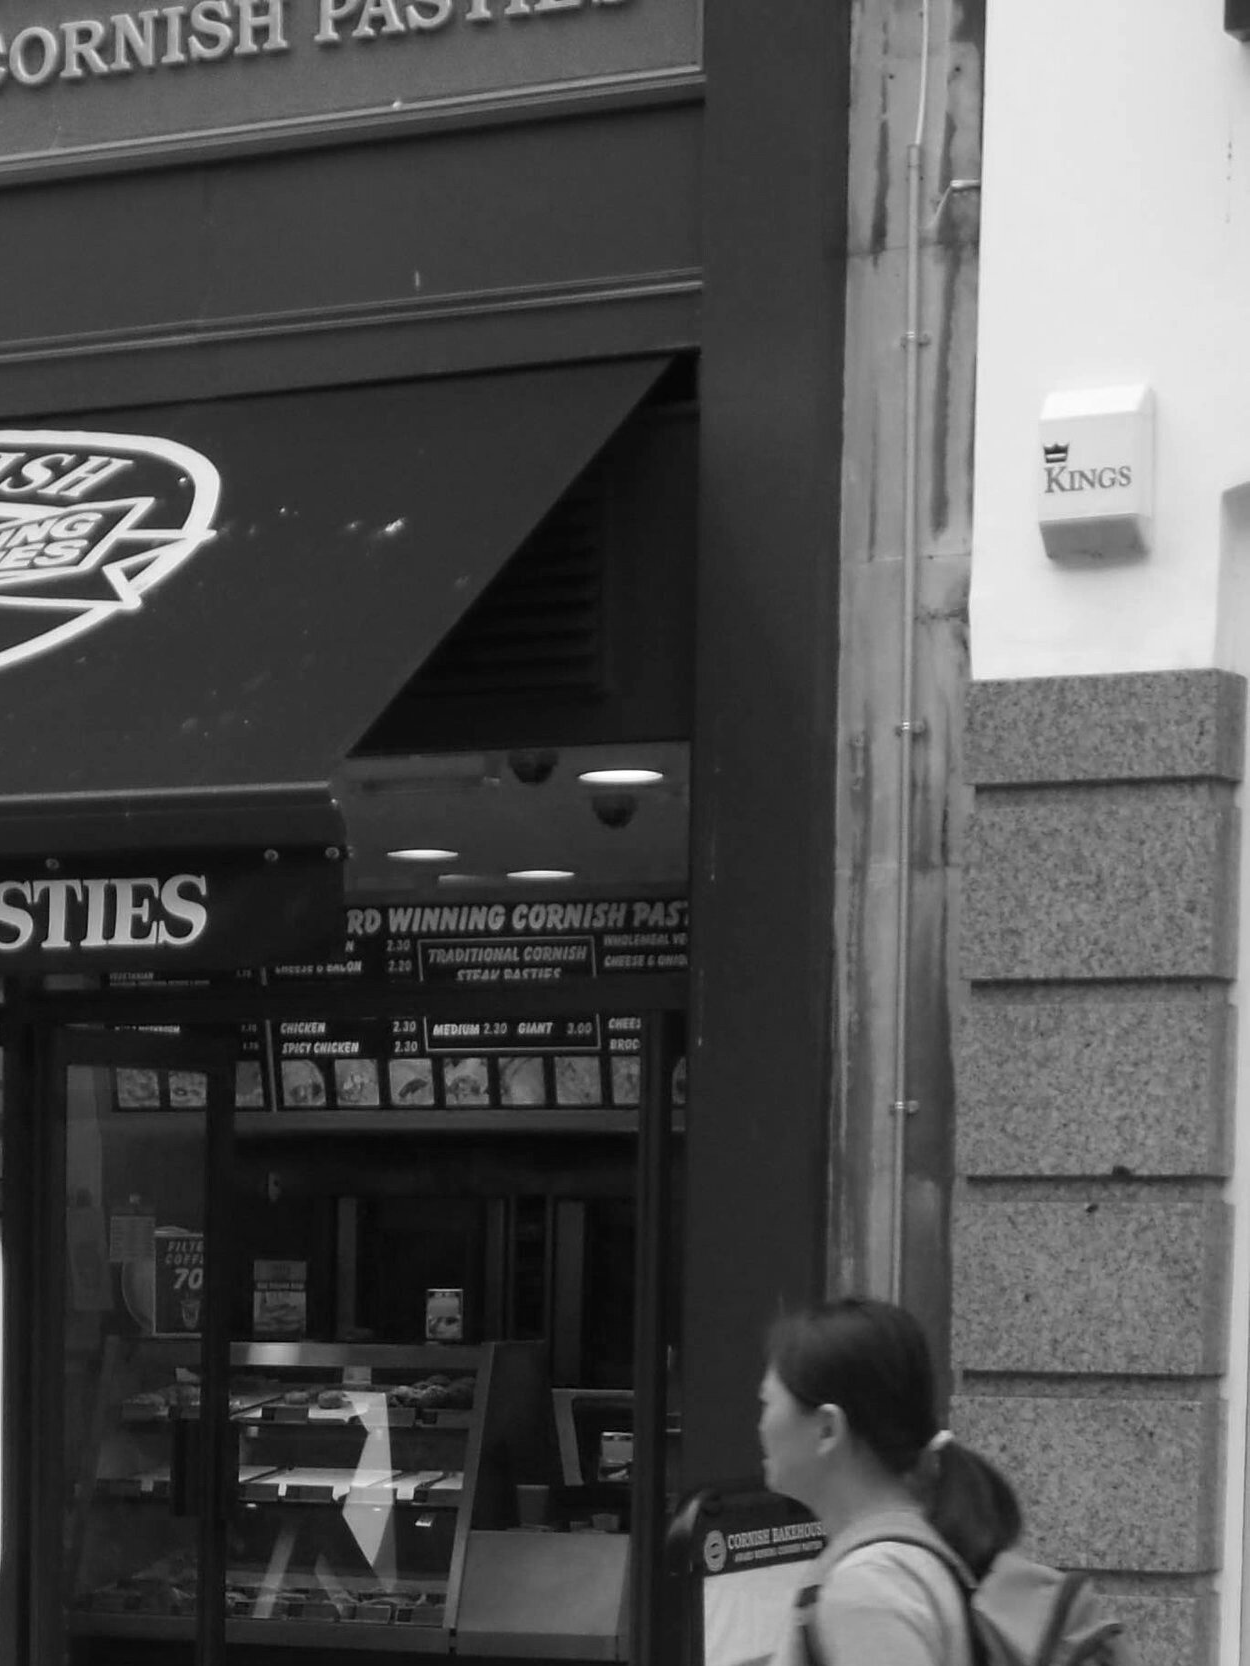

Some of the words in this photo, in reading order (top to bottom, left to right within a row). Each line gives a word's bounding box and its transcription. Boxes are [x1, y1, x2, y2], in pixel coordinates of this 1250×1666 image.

[388, 903, 507, 934] WINNING
[511, 901, 627, 931] CORNISH
[428, 947, 521, 965] TRADITIONAL
[523, 944, 588, 962] CORNISH
[280, 1021, 326, 1036] CHICKEN
[393, 1019, 418, 1034] 2.30
[432, 1022, 481, 1037] MEDIUM
[483, 1022, 508, 1036] 2.30
[517, 1021, 554, 1036] GIANT
[282, 1042, 312, 1056] SPICY
[313, 1040, 360, 1056] CHICKEN
[168, 1240, 203, 1252] FILTE
[728, 1529, 770, 1550] CORNISH
[772, 1521, 827, 1543] BAKEHOUS
